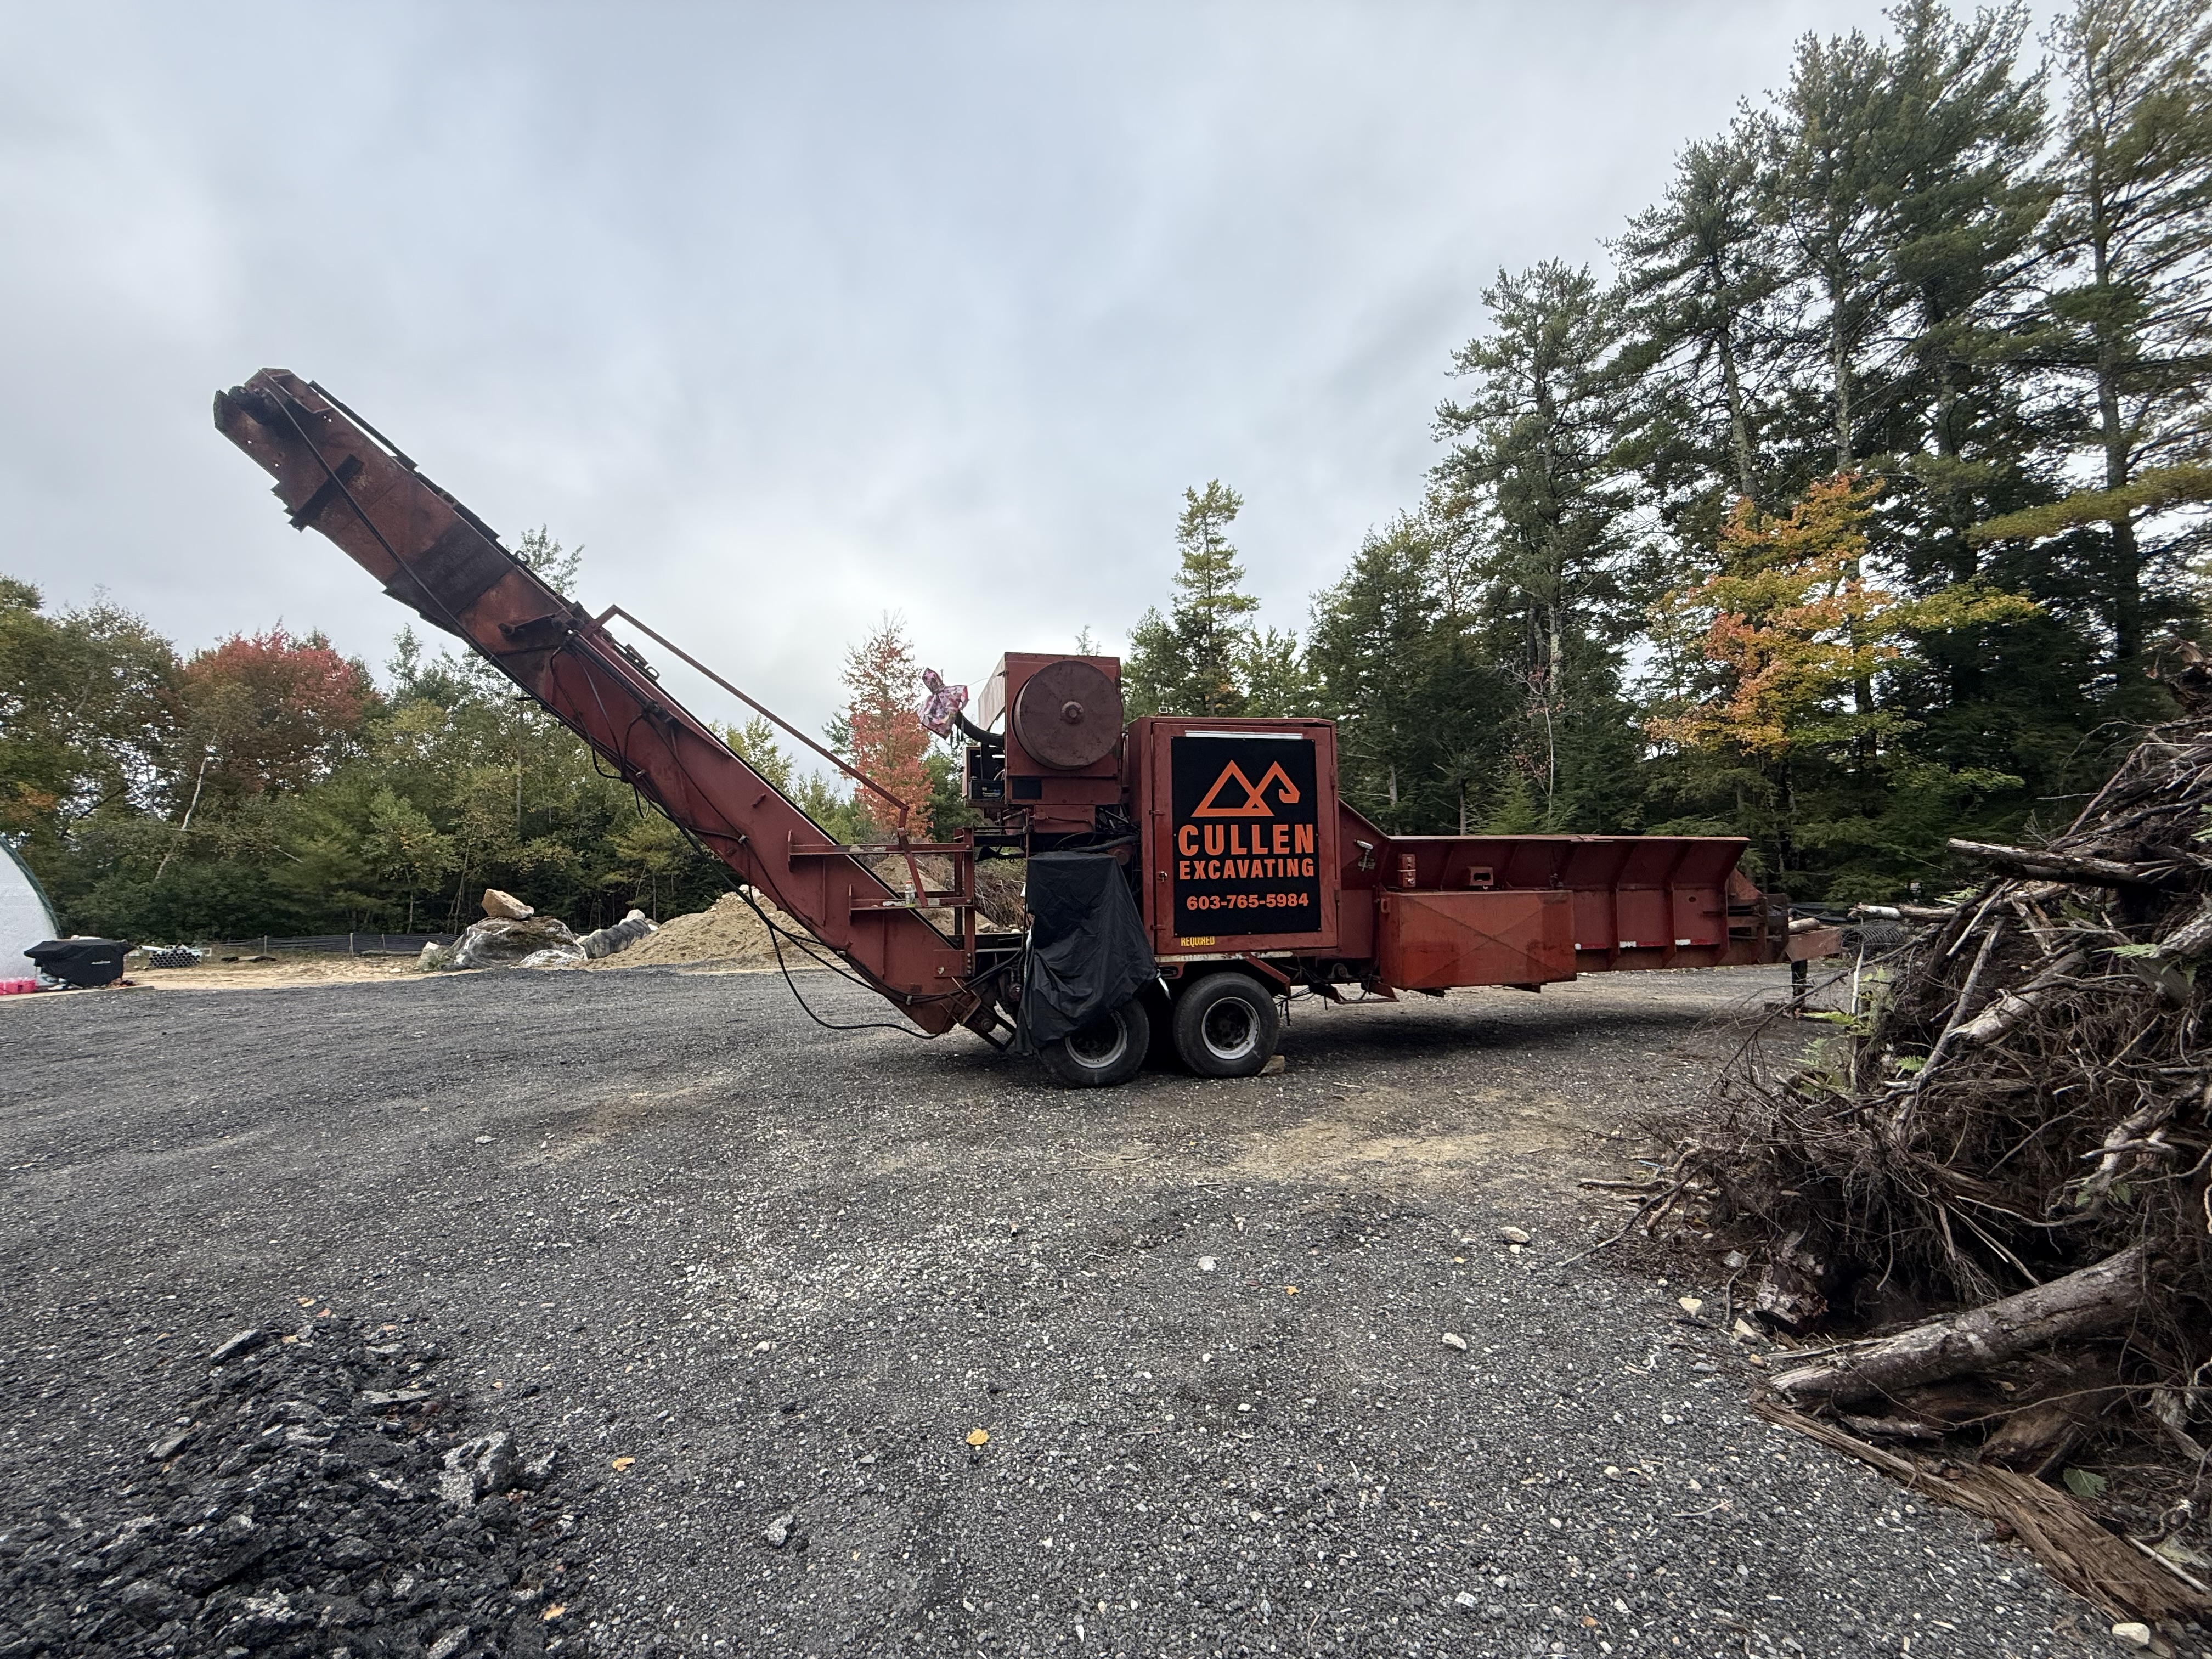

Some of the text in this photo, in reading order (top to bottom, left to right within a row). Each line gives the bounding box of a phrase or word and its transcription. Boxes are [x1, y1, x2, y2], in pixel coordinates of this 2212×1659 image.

[1178, 824, 1314, 856] CULLEN
[1179, 857, 1314, 880] EXCAVATING
[1186, 893, 1309, 910] 603-765-5984
[1181, 936, 1215, 948] REQUIRED
